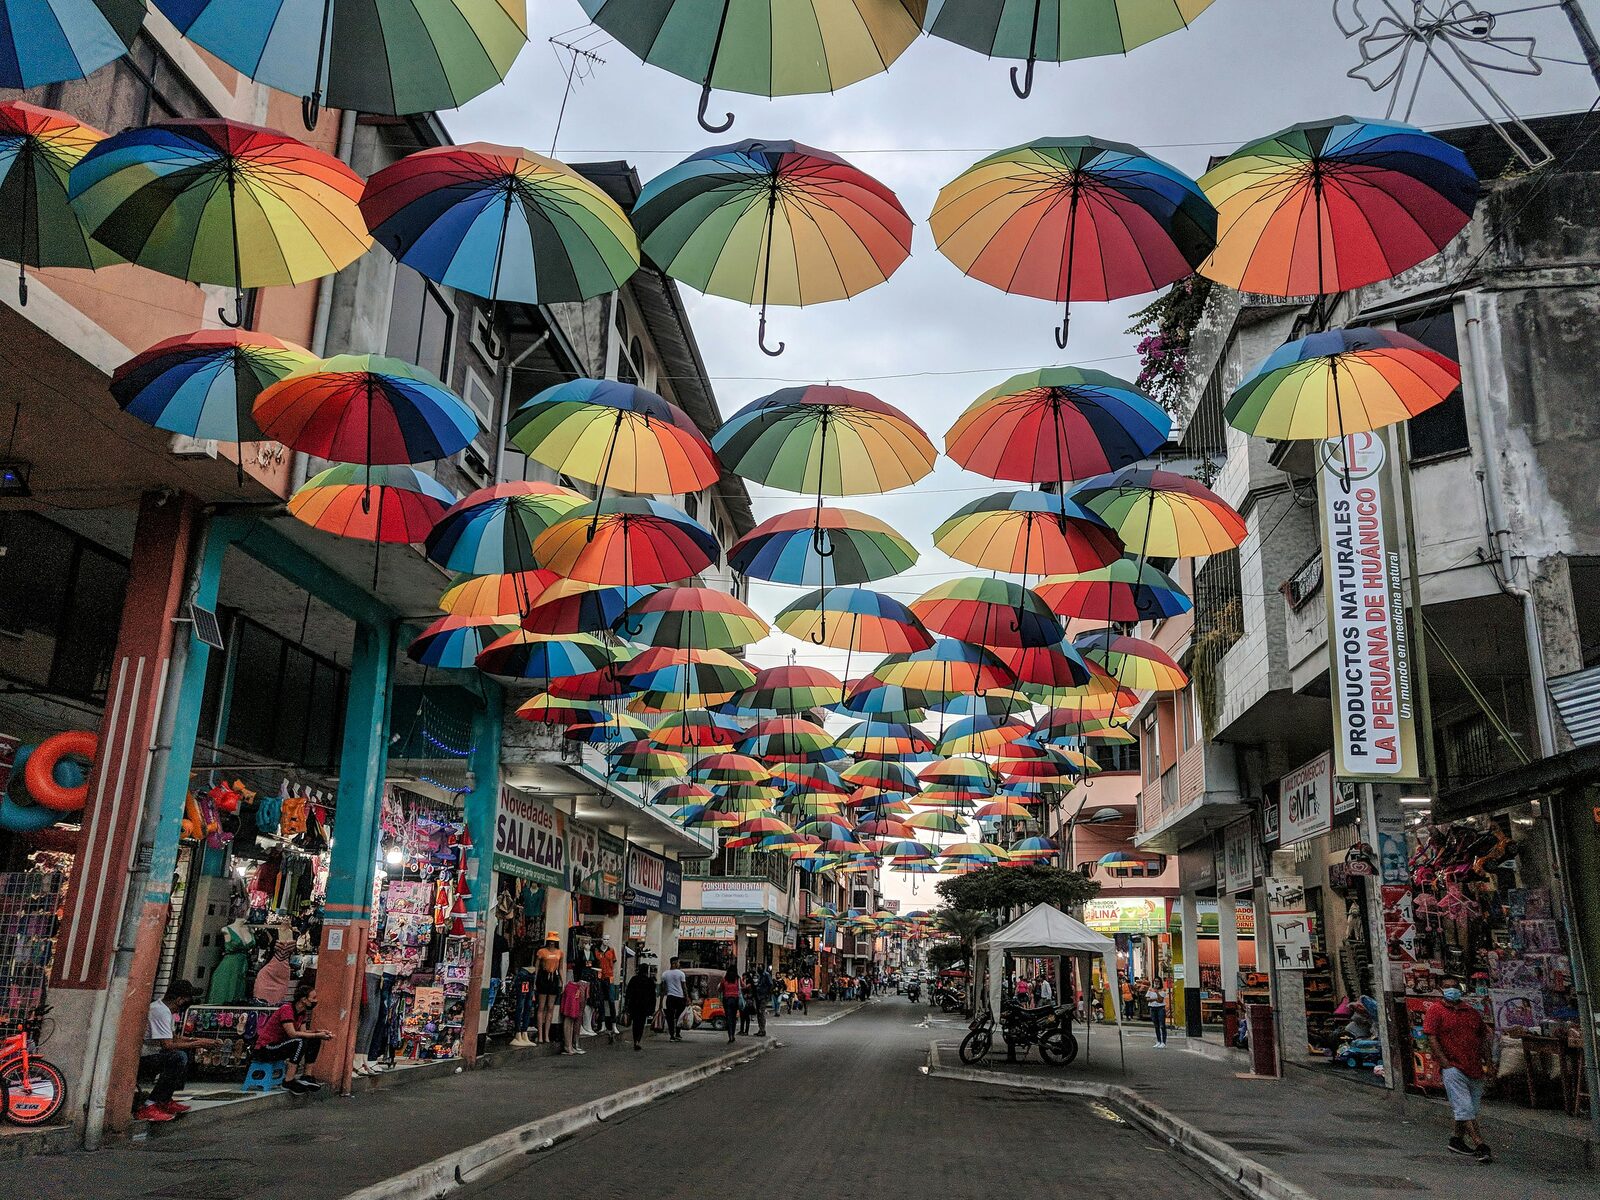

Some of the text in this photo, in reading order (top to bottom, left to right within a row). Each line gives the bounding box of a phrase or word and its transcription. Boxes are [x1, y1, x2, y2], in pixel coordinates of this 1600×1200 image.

[1334, 500, 1368, 757] PRODUCTOS NATURALES
[1355, 487, 1398, 765] LA PERUANA DE HUÁNUCO
[1387, 551, 1411, 720] Un mundo en medicina natural
[496, 814, 564, 872] SALAZAR
[501, 787, 553, 830] Novedades
[702, 881, 741, 891] CONSULTORIO
